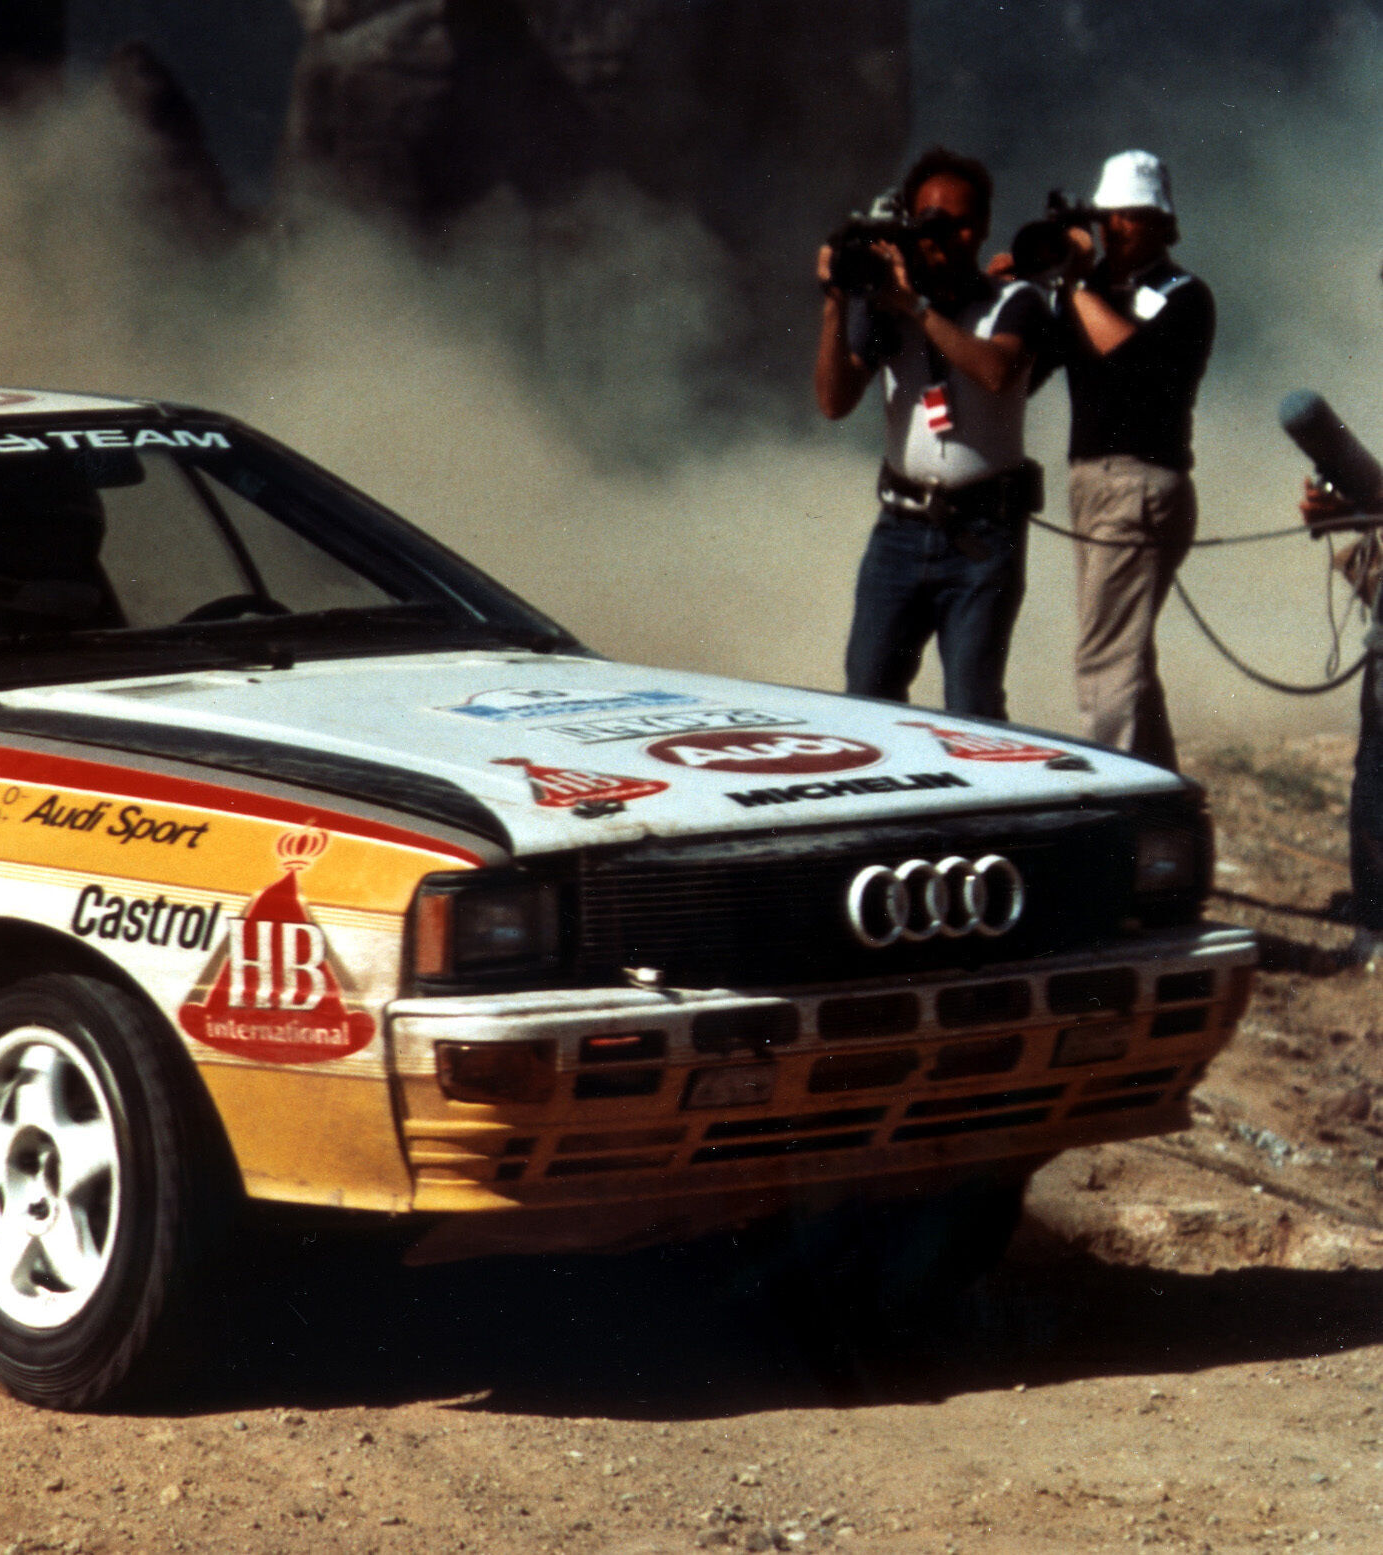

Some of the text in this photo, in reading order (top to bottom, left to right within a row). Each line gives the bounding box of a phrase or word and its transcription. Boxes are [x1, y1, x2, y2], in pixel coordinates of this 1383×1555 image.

[47, 428, 232, 450] TEAM
[724, 772, 972, 808] MICHELIN
[22, 795, 211, 849] Audi Sport
[70, 883, 222, 951] Castrol
[225, 917, 327, 1012] HB
[204, 1014, 352, 1046] international
